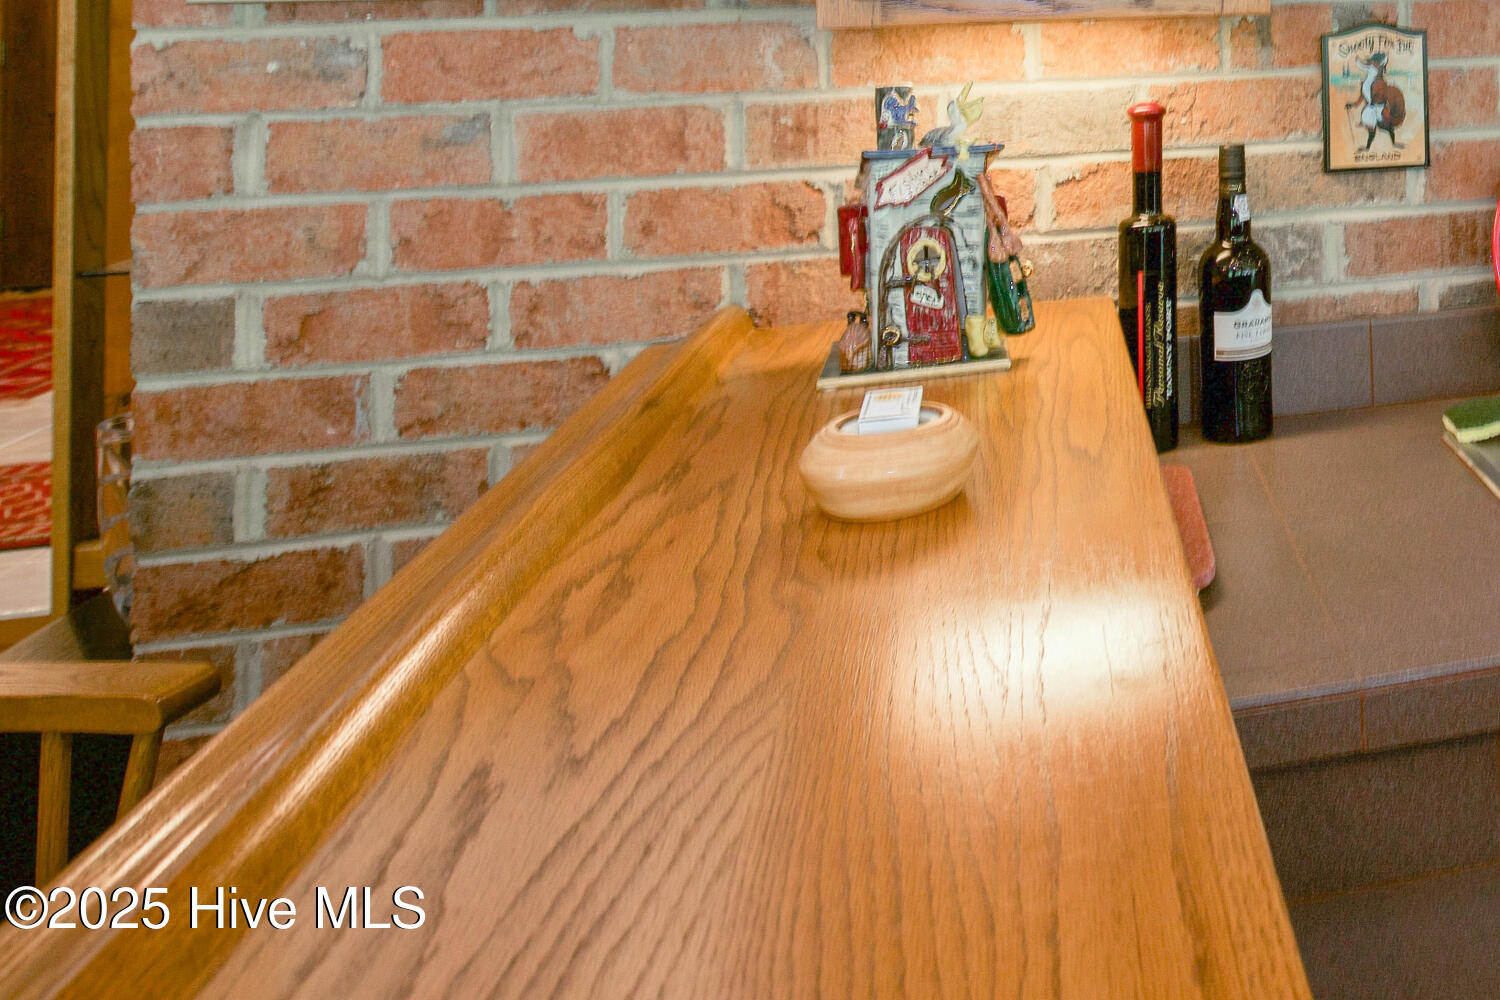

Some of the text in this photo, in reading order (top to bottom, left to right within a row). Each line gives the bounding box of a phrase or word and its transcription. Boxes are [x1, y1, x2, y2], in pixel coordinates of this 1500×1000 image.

[1354, 150, 1401, 162] ENGLAND
[1152, 281, 1165, 409] Personal Reserve
[1165, 342, 1173, 400] TAWNY
